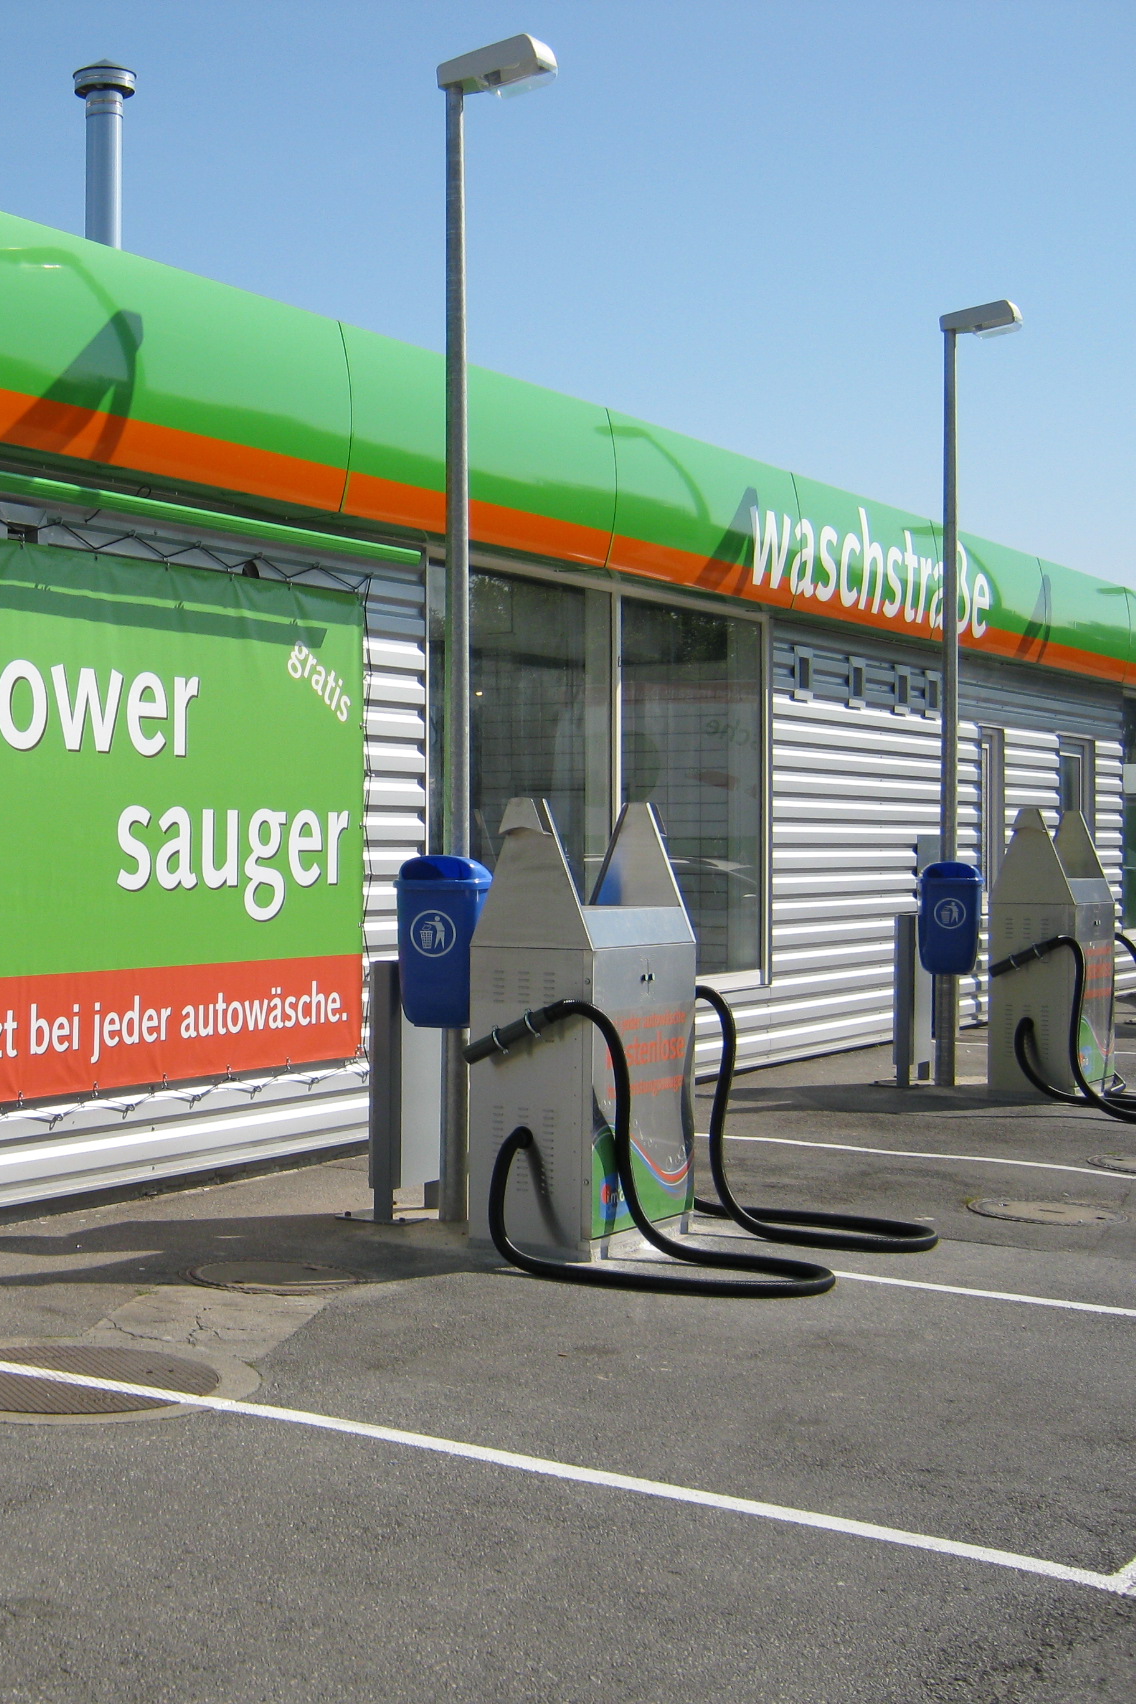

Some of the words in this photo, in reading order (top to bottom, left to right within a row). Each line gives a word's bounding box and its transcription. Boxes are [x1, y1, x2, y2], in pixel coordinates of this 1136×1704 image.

[287, 640, 353, 723] gratis
[117, 804, 350, 922] sauger
[30, 1000, 80, 1055] bei
[90, 995, 172, 1064] jeder
[180, 980, 349, 1038] autowäsche.
[606, 1030, 686, 1070] stenlose
